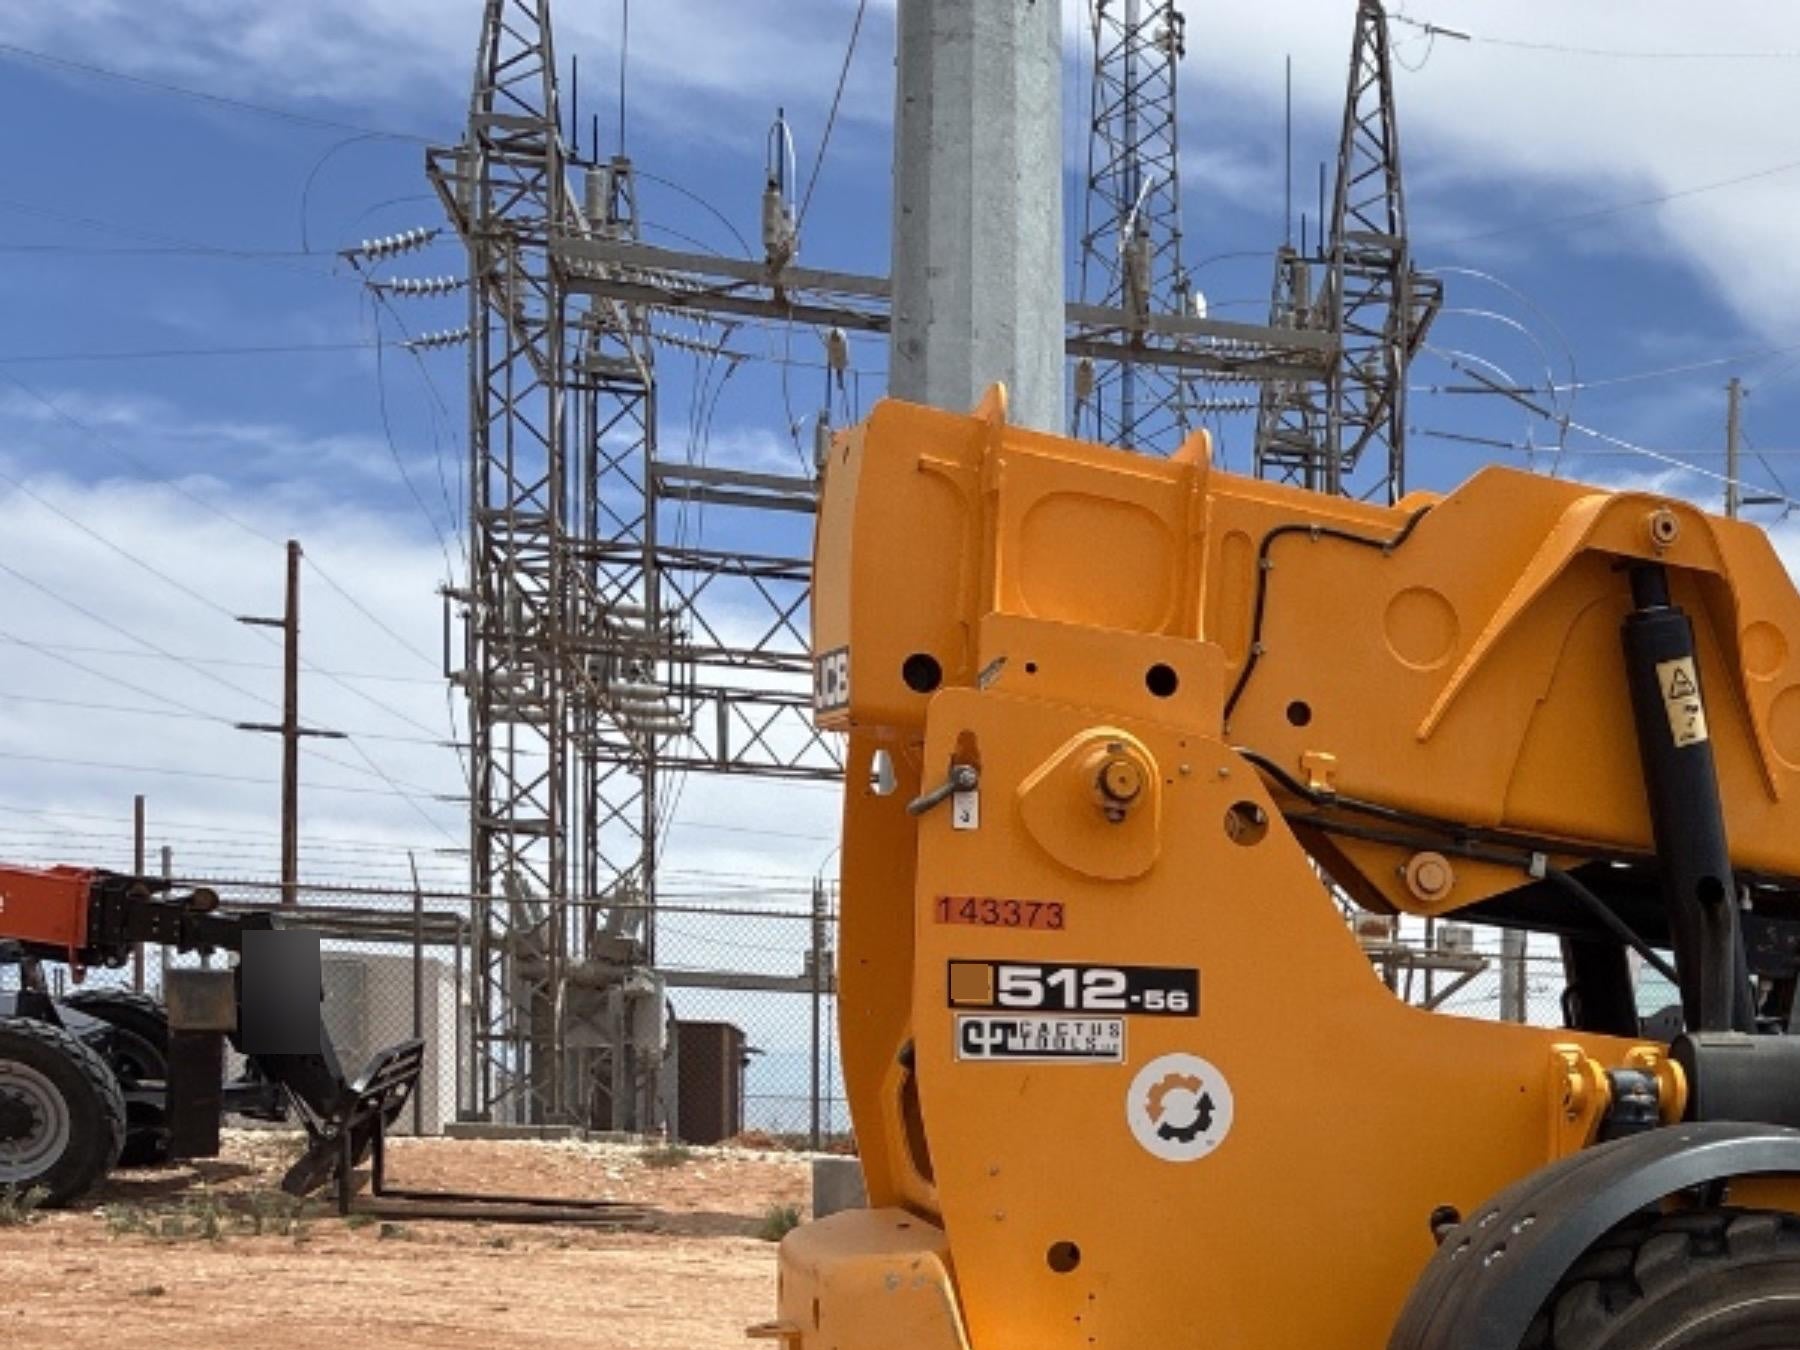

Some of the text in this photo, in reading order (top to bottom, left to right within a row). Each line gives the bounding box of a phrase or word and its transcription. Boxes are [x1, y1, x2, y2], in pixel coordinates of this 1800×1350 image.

[937, 896, 1065, 930] 143373
[997, 965, 1189, 1012] 512-56
[1020, 1020, 1120, 1039] CACTUS
